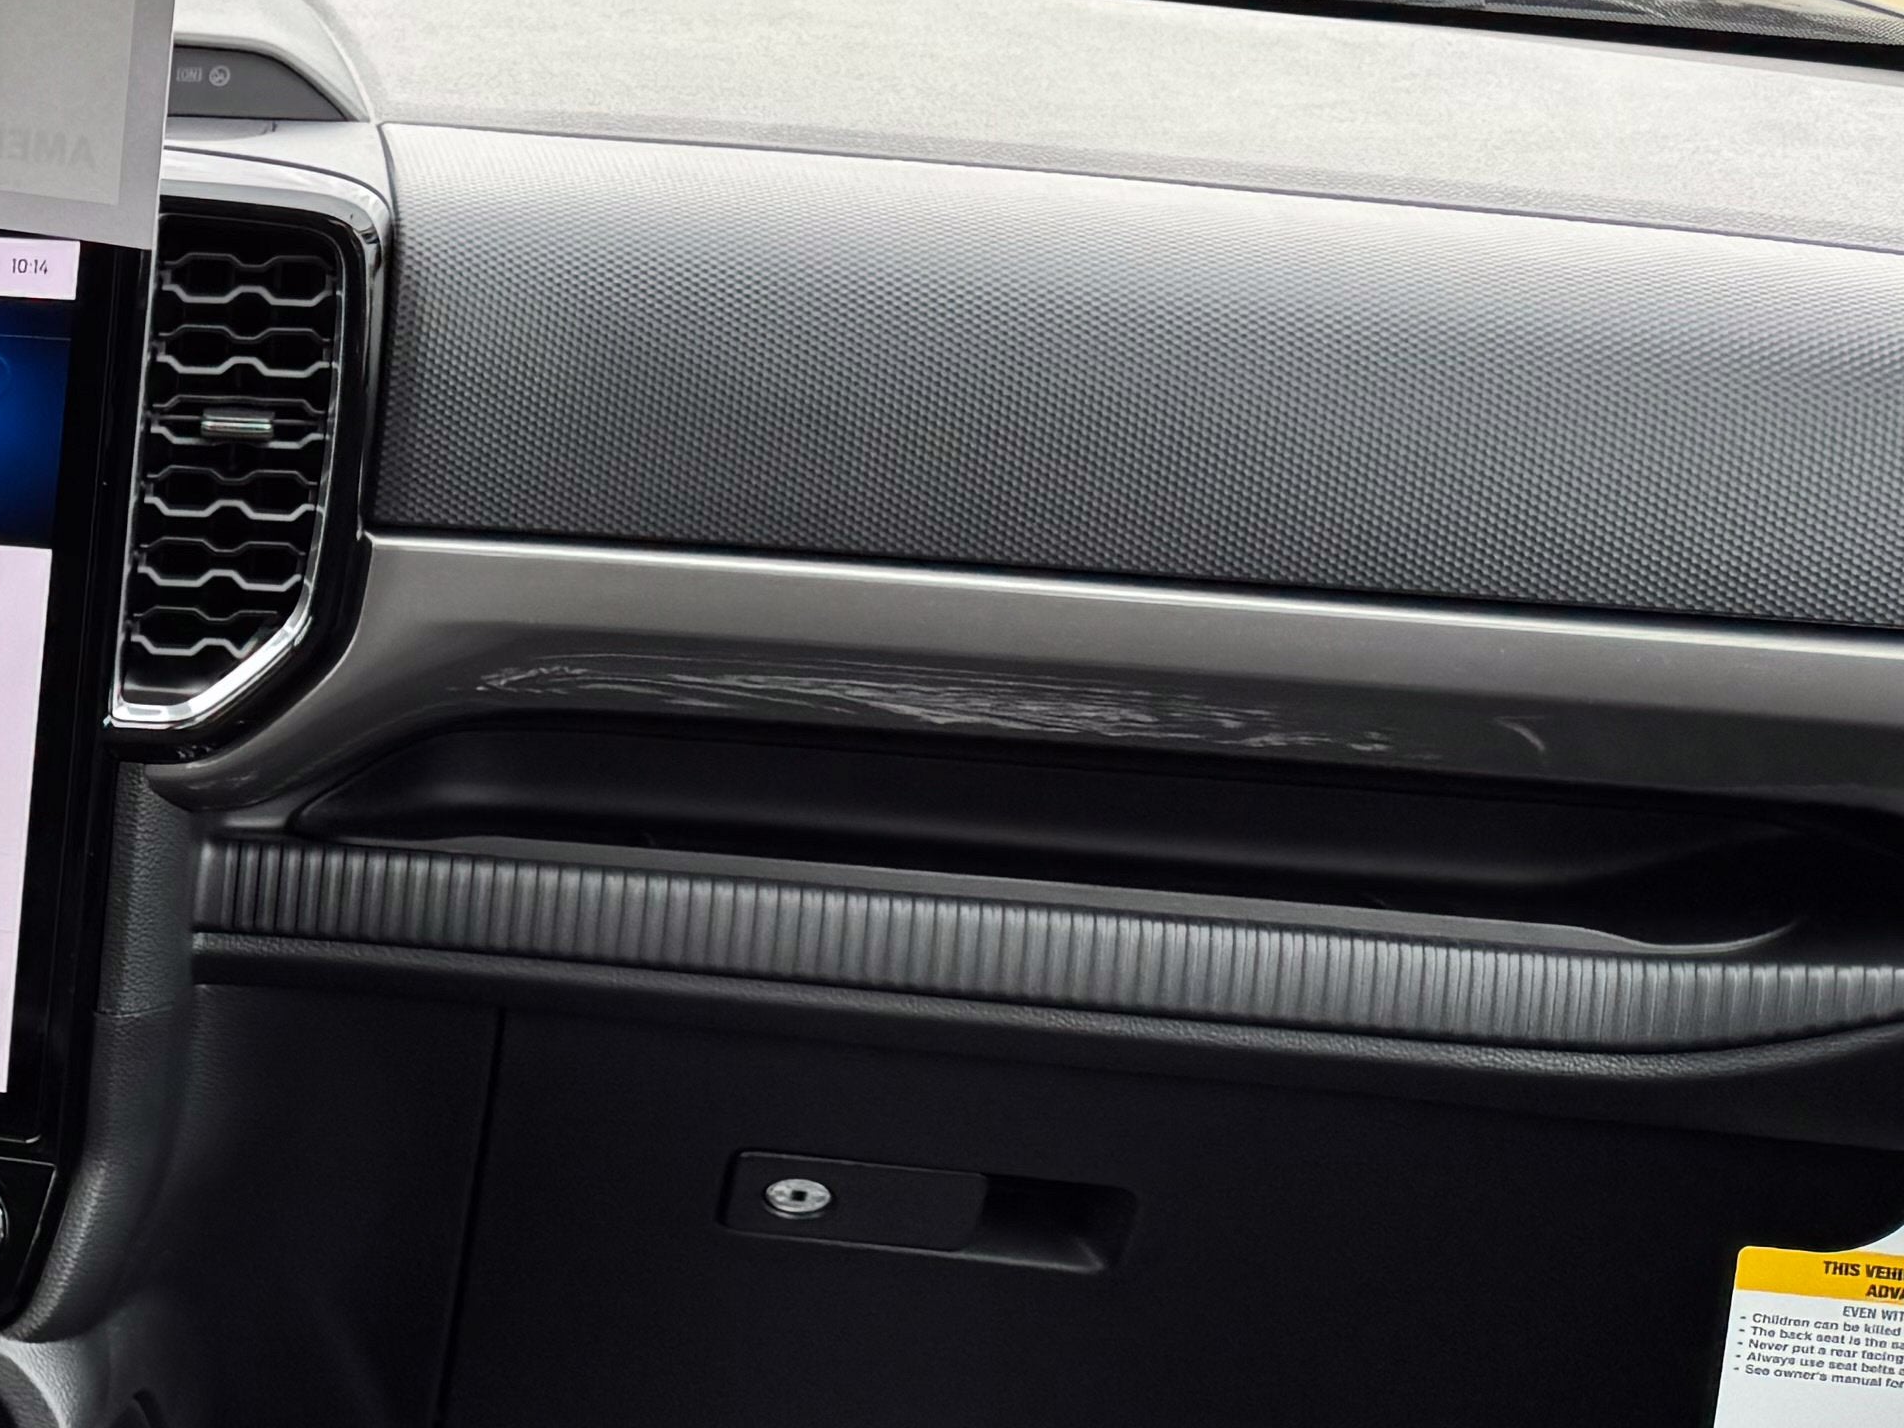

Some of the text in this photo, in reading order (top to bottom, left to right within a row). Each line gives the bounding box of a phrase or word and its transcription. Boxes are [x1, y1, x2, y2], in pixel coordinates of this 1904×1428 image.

[10, 256, 49, 276] 10:14
[1823, 1260, 1861, 1277] THIS
[1842, 1305, 1877, 1319] EVEN
[1752, 1313, 1902, 1337] Children can be killed
[1751, 1326, 1776, 1337] The
[1779, 1328, 1812, 1341] back
[1816, 1333, 1845, 1344] seat
[1849, 1335, 1861, 1346] is
[1865, 1337, 1887, 1348] the
[1748, 1339, 1904, 1365] Never put a rear facing
[1746, 1352, 1896, 1376] Always use seat belts
[1745, 1364, 1904, 1389] See owner's manual for
